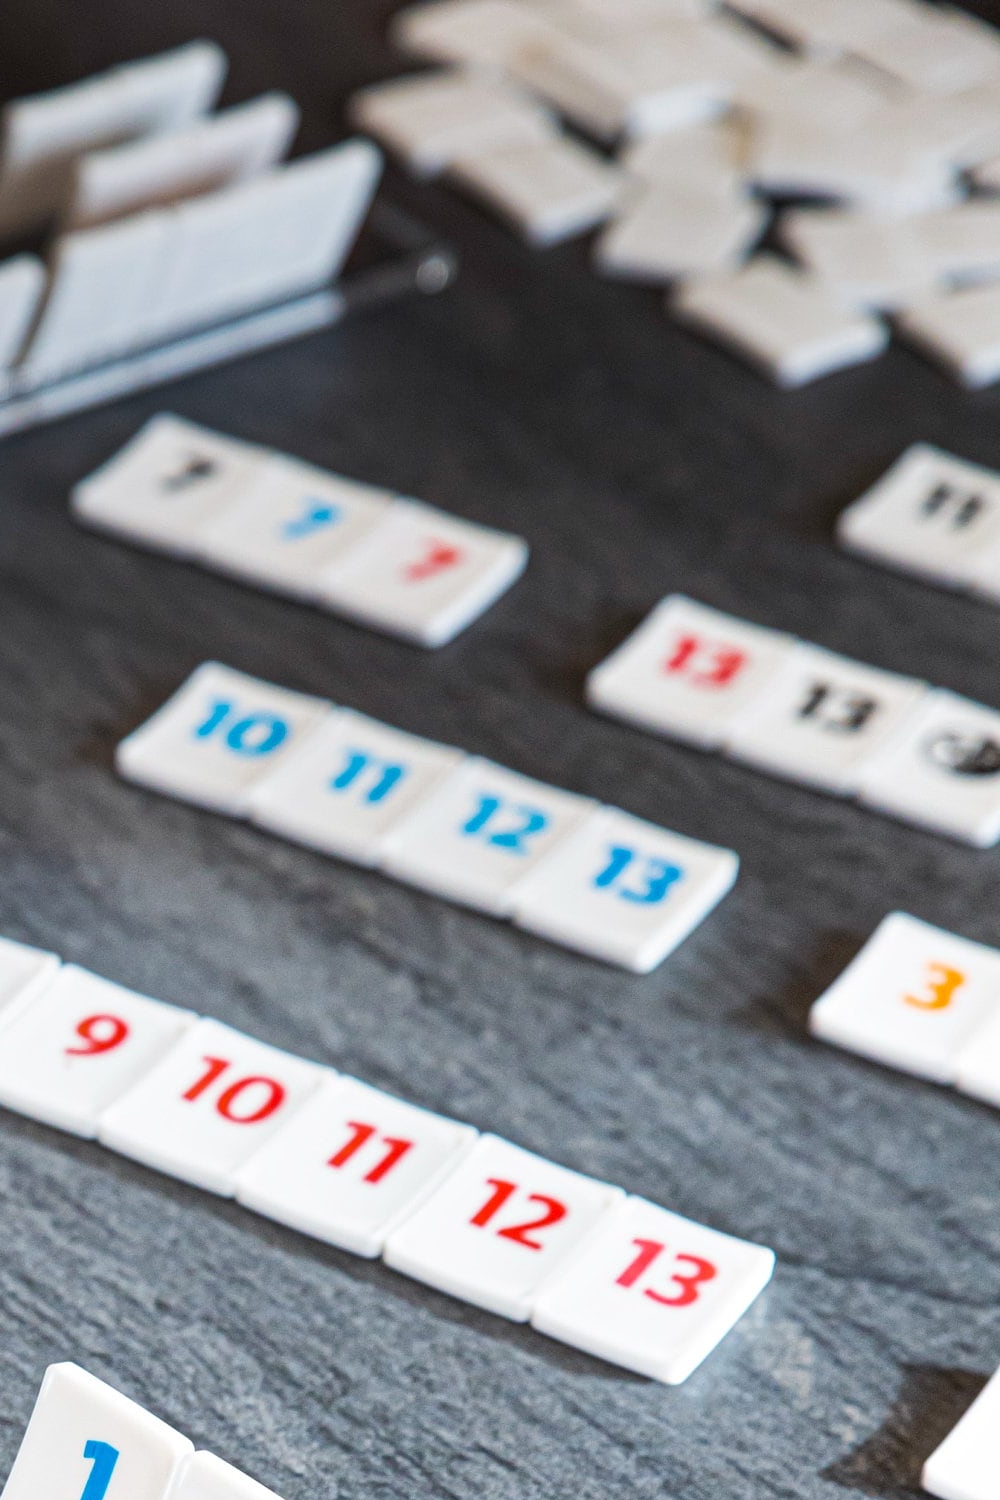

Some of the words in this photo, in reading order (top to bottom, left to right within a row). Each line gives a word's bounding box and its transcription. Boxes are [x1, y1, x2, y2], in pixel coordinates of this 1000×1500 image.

[280, 496, 341, 541] 7
[402, 537, 464, 584] 7
[921, 480, 983, 529] 11
[662, 629, 750, 692] 13
[797, 680, 881, 737] 13
[193, 697, 291, 758] 10
[328, 748, 408, 806] 11
[459, 792, 550, 855] 12
[591, 843, 686, 907] 13
[902, 960, 968, 1013] 3
[65, 1013, 131, 1058] 9
[181, 1055, 288, 1126] 10
[326, 1120, 415, 1186] 11
[468, 1177, 569, 1252] 12
[614, 1237, 719, 1309] 13
